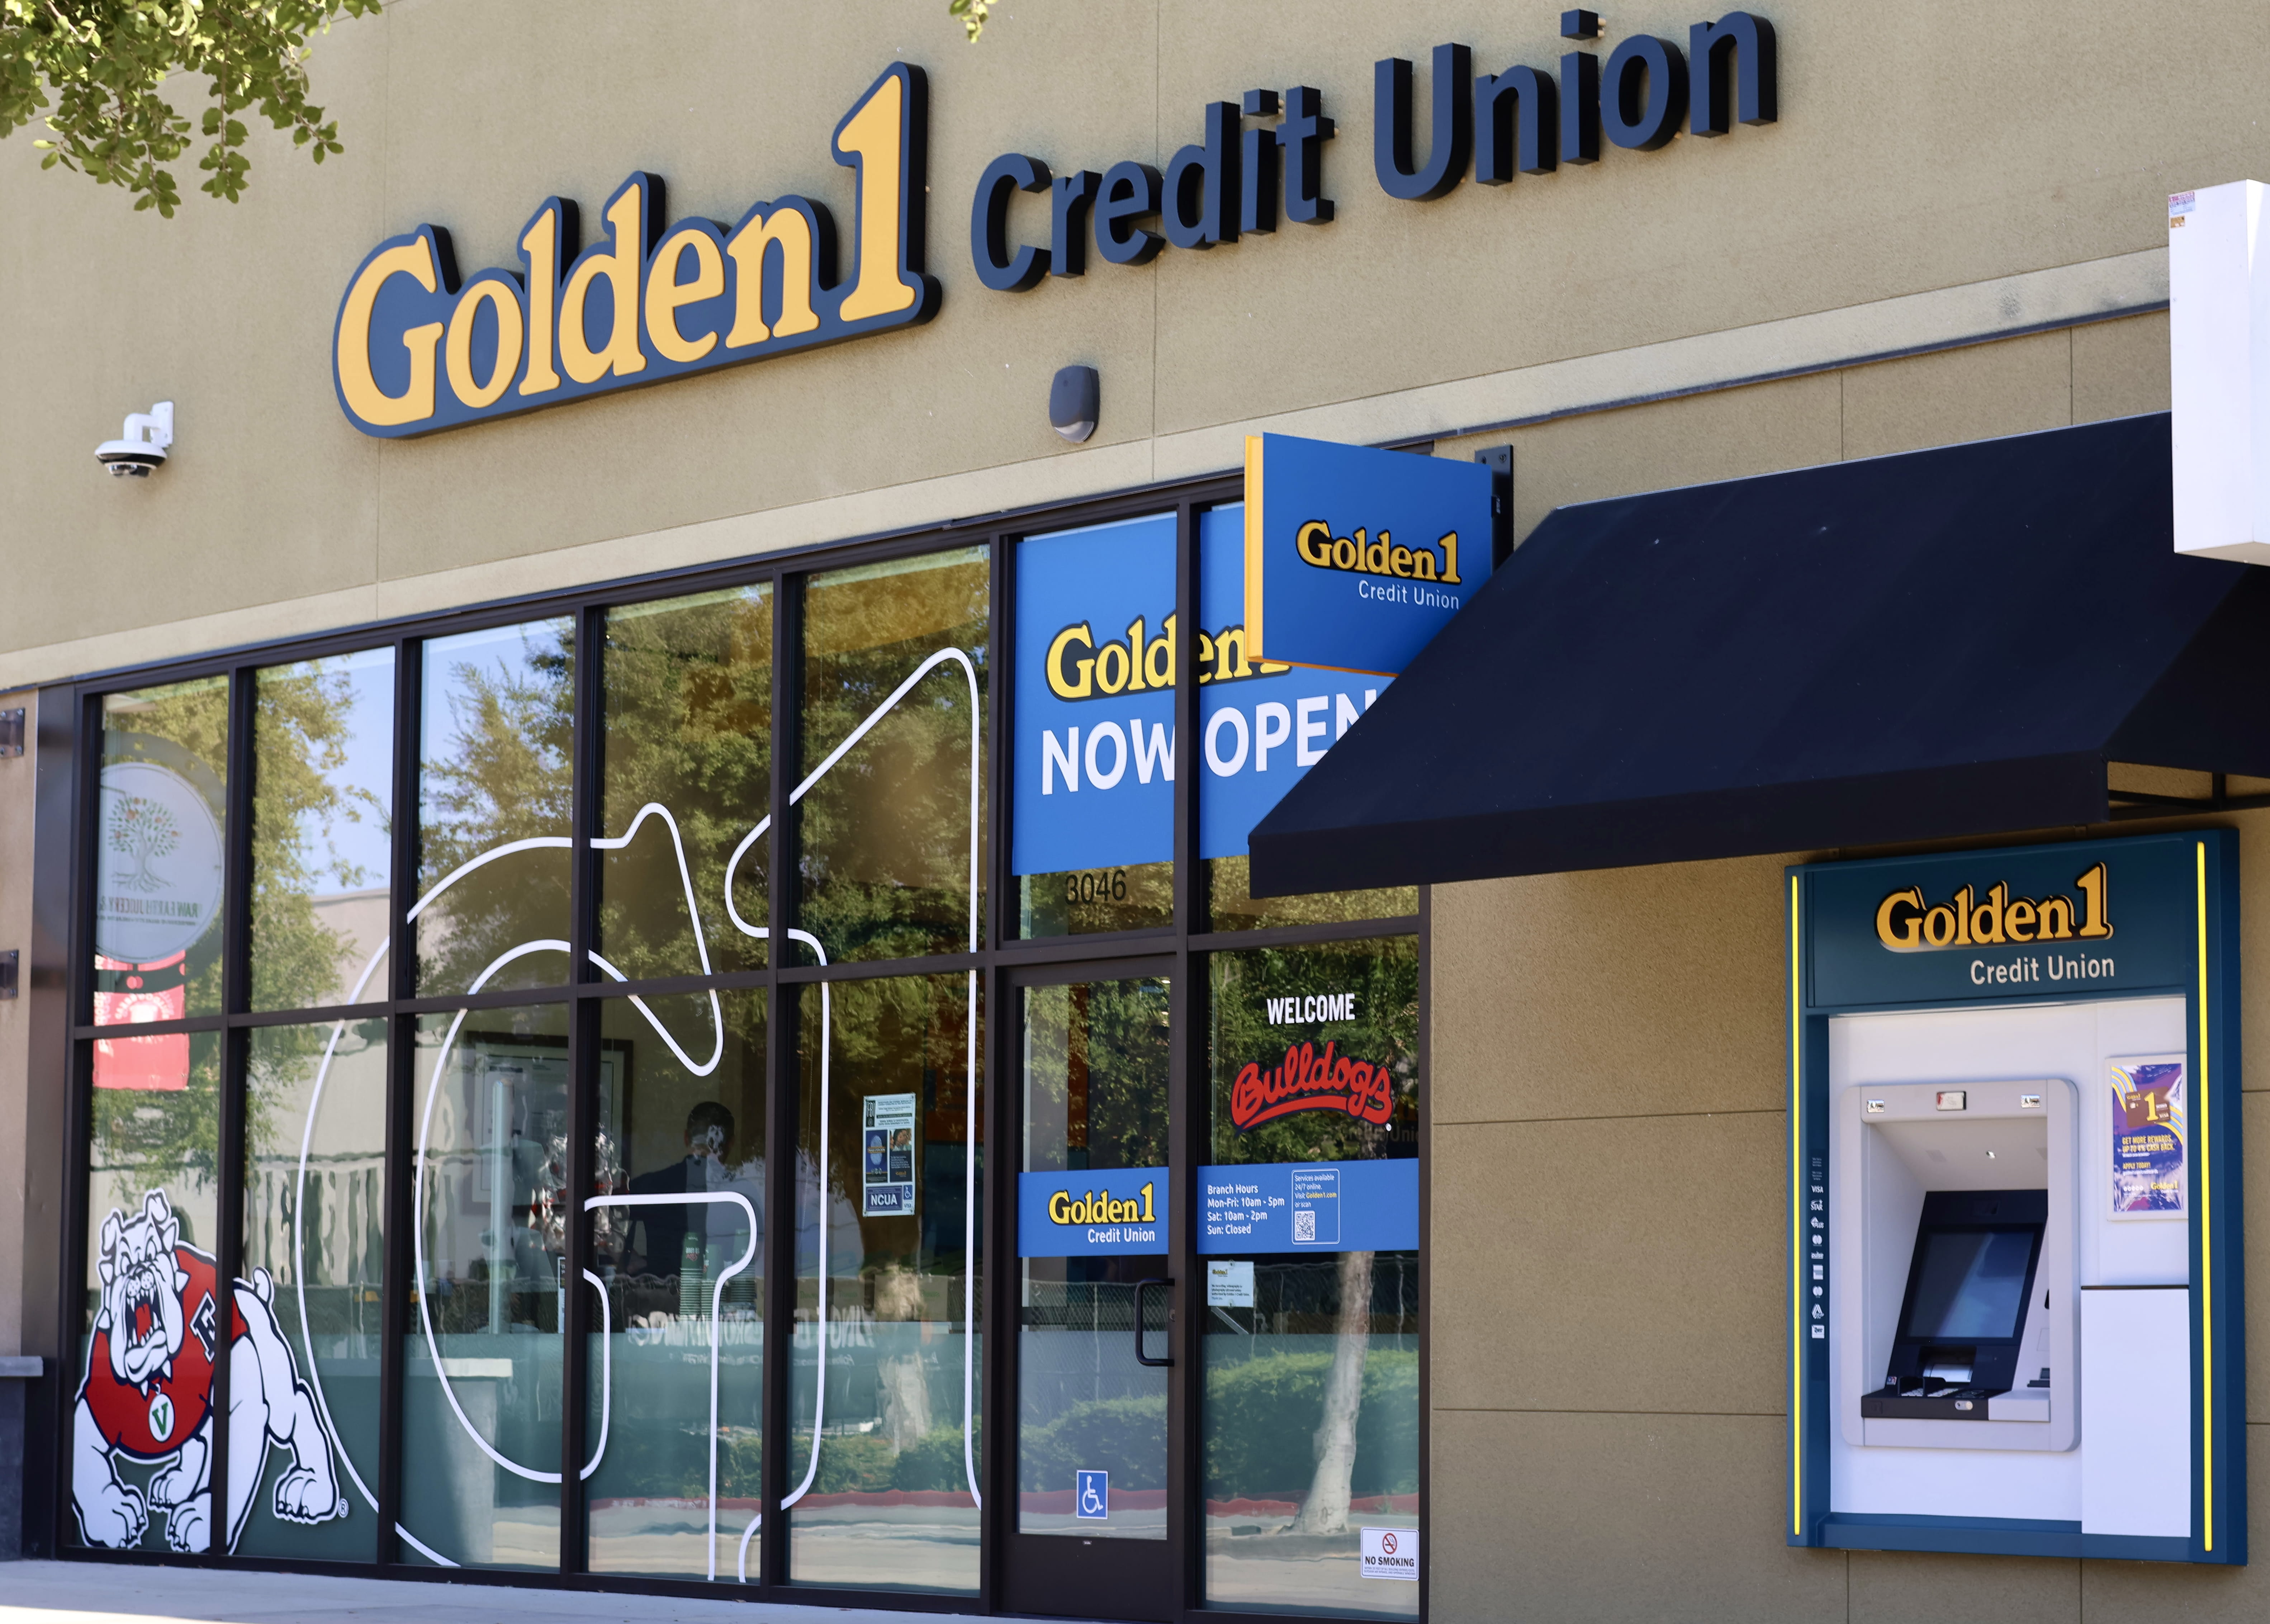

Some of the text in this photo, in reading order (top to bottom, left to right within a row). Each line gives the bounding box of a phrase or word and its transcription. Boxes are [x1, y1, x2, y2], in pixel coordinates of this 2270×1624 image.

[336, 9, 1777, 427] Golden1 Credit Union
[1296, 521, 1461, 584] Golden1
[1359, 579, 1459, 610] Credit Union
[1046, 614, 1290, 698] Goldn
[1042, 718, 1175, 795] NOW
[1065, 870, 1127, 906] 3046
[1876, 865, 2108, 948] Golden1
[1971, 954, 2115, 985] Credit Union
[1266, 993, 1355, 1025] WELCOME
[1231, 1040, 1393, 1128] Bulldogs
[2147, 1143, 2160, 1151] CASH
[871, 1193, 898, 1206] NCUA
[1207, 1183, 1259, 1195] Branch Hours
[1207, 1197, 1239, 1208] Mon-Fri:
[1241, 1197, 1261, 1207] 10am
[1268, 1196, 1285, 1208] 5pm
[1295, 1183, 1306, 1191] 24/7
[1049, 1183, 1156, 1224] Golden1
[1207, 1212, 1222, 1222] Sat:
[1224, 1212, 1245, 1221] 10am
[1251, 1210, 1267, 1222] 2pm
[1087, 1228, 1155, 1243] Credit Union
[1207, 1223, 1251, 1235] Sun: Closed
[151, 1401, 168, 1436] V
[1365, 1556, 1414, 1567] NO SMOKING
